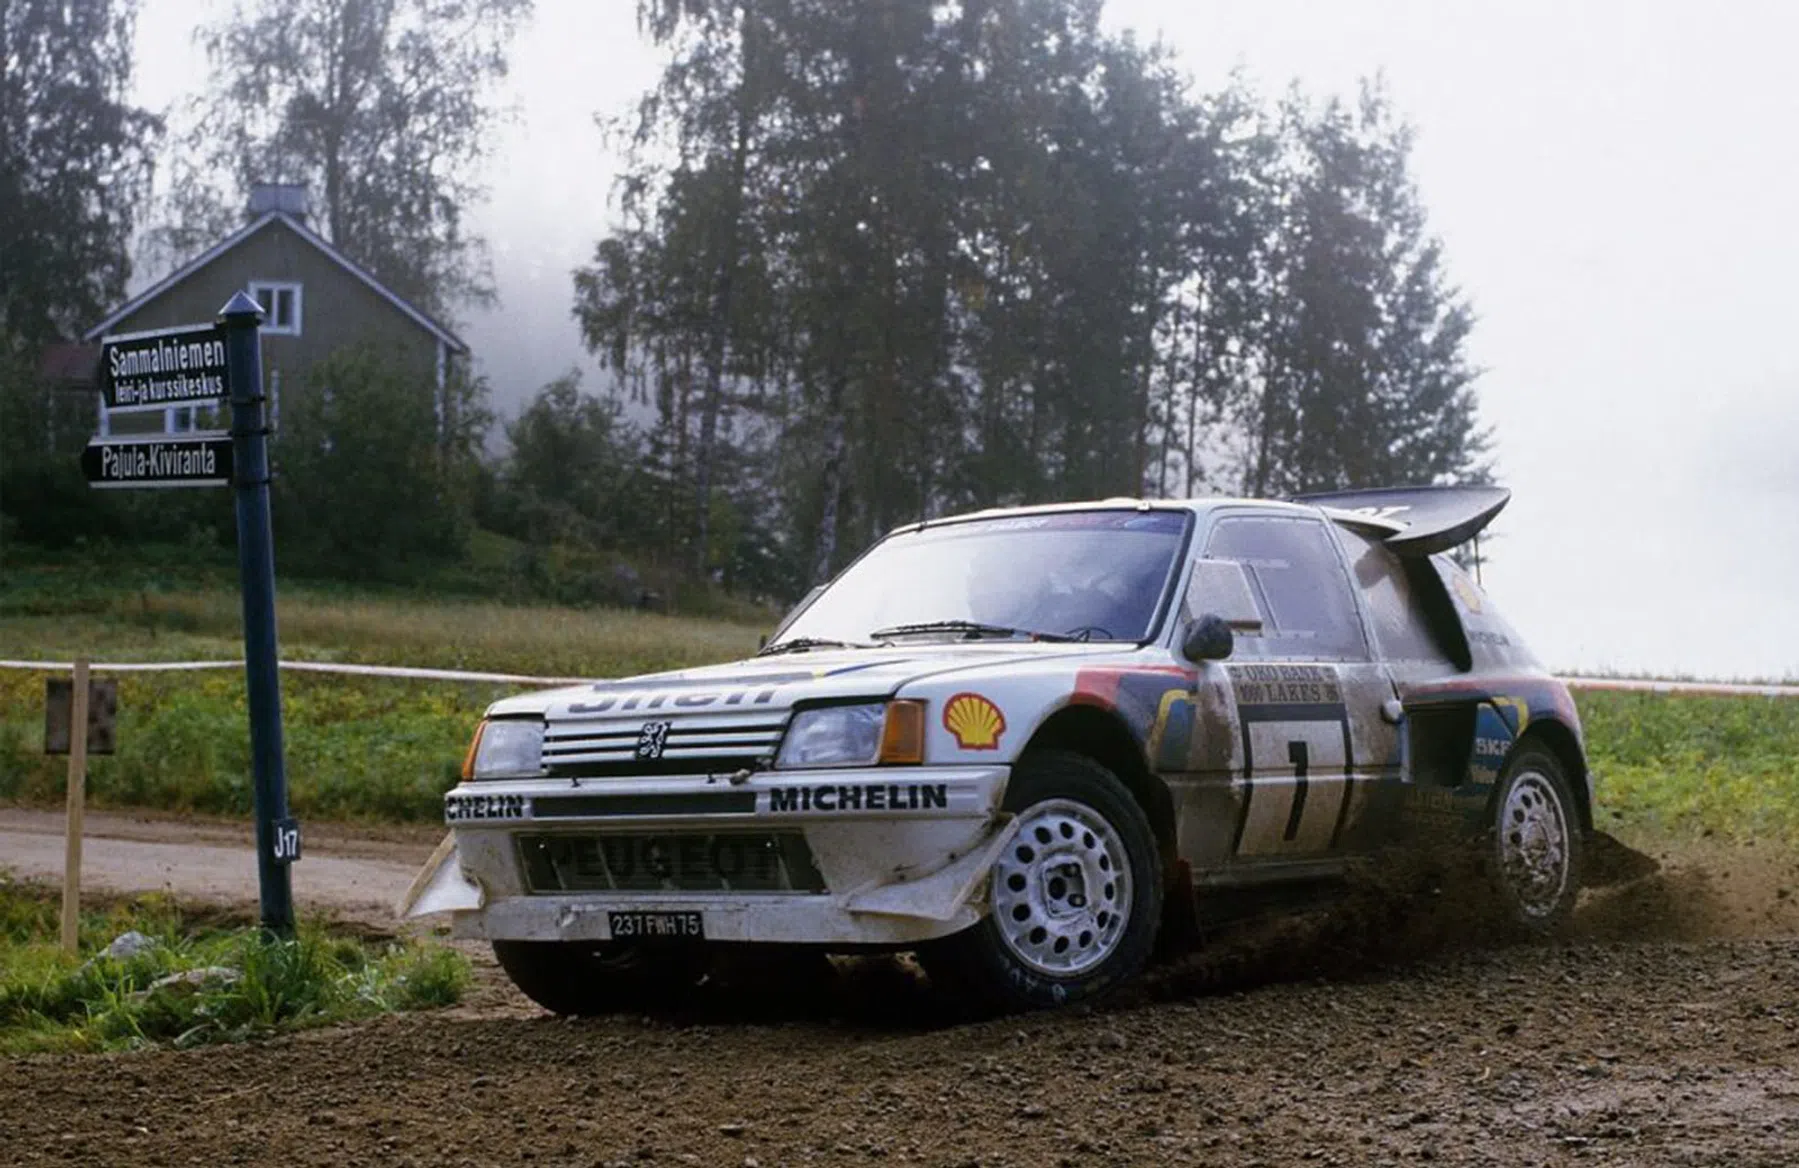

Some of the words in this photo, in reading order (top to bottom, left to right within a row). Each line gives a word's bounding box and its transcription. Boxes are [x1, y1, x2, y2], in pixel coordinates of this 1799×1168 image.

[109, 338, 225, 377] Sammalniemen
[149, 372, 223, 400] kurssikeskus
[101, 443, 216, 479] Pajula-Kiviranta
[1265, 683, 1321, 702] LAKES
[770, 784, 947, 811] MICHELIN
[1283, 740, 1308, 841] 1
[274, 827, 298, 857] J17
